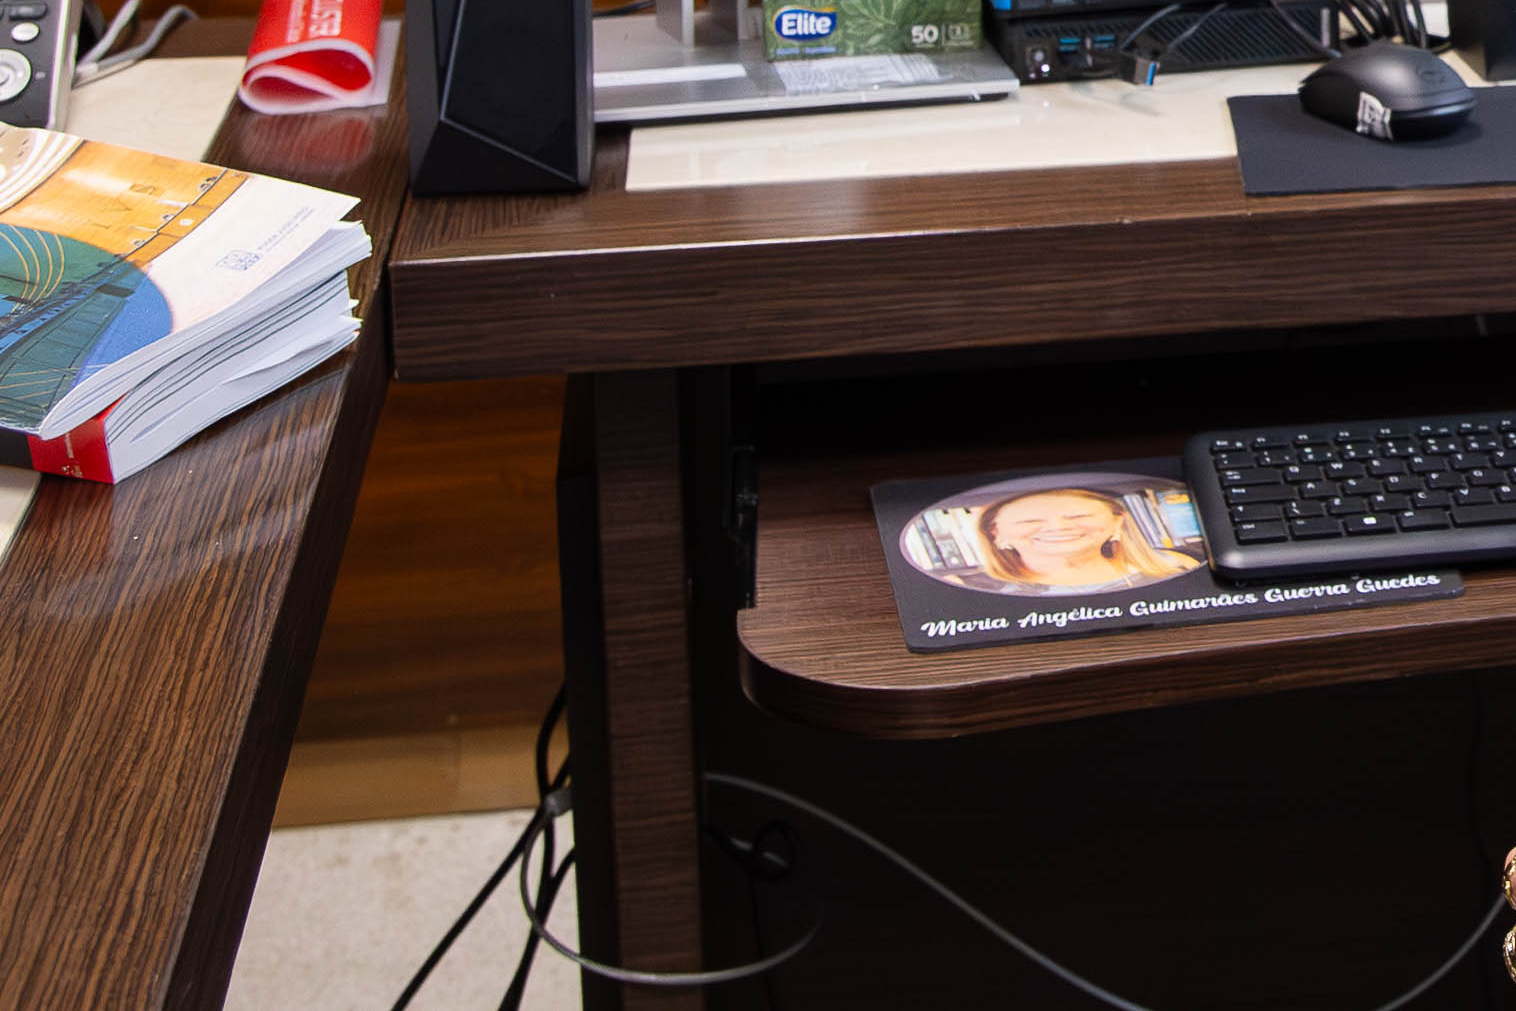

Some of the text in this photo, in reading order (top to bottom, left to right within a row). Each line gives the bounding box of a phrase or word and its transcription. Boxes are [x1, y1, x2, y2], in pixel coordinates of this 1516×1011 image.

[780, 11, 833, 38] Elite
[910, 24, 939, 44] 50
[919, 572, 1441, 638] Maria Angélica Guimarães Guerra Guedes
